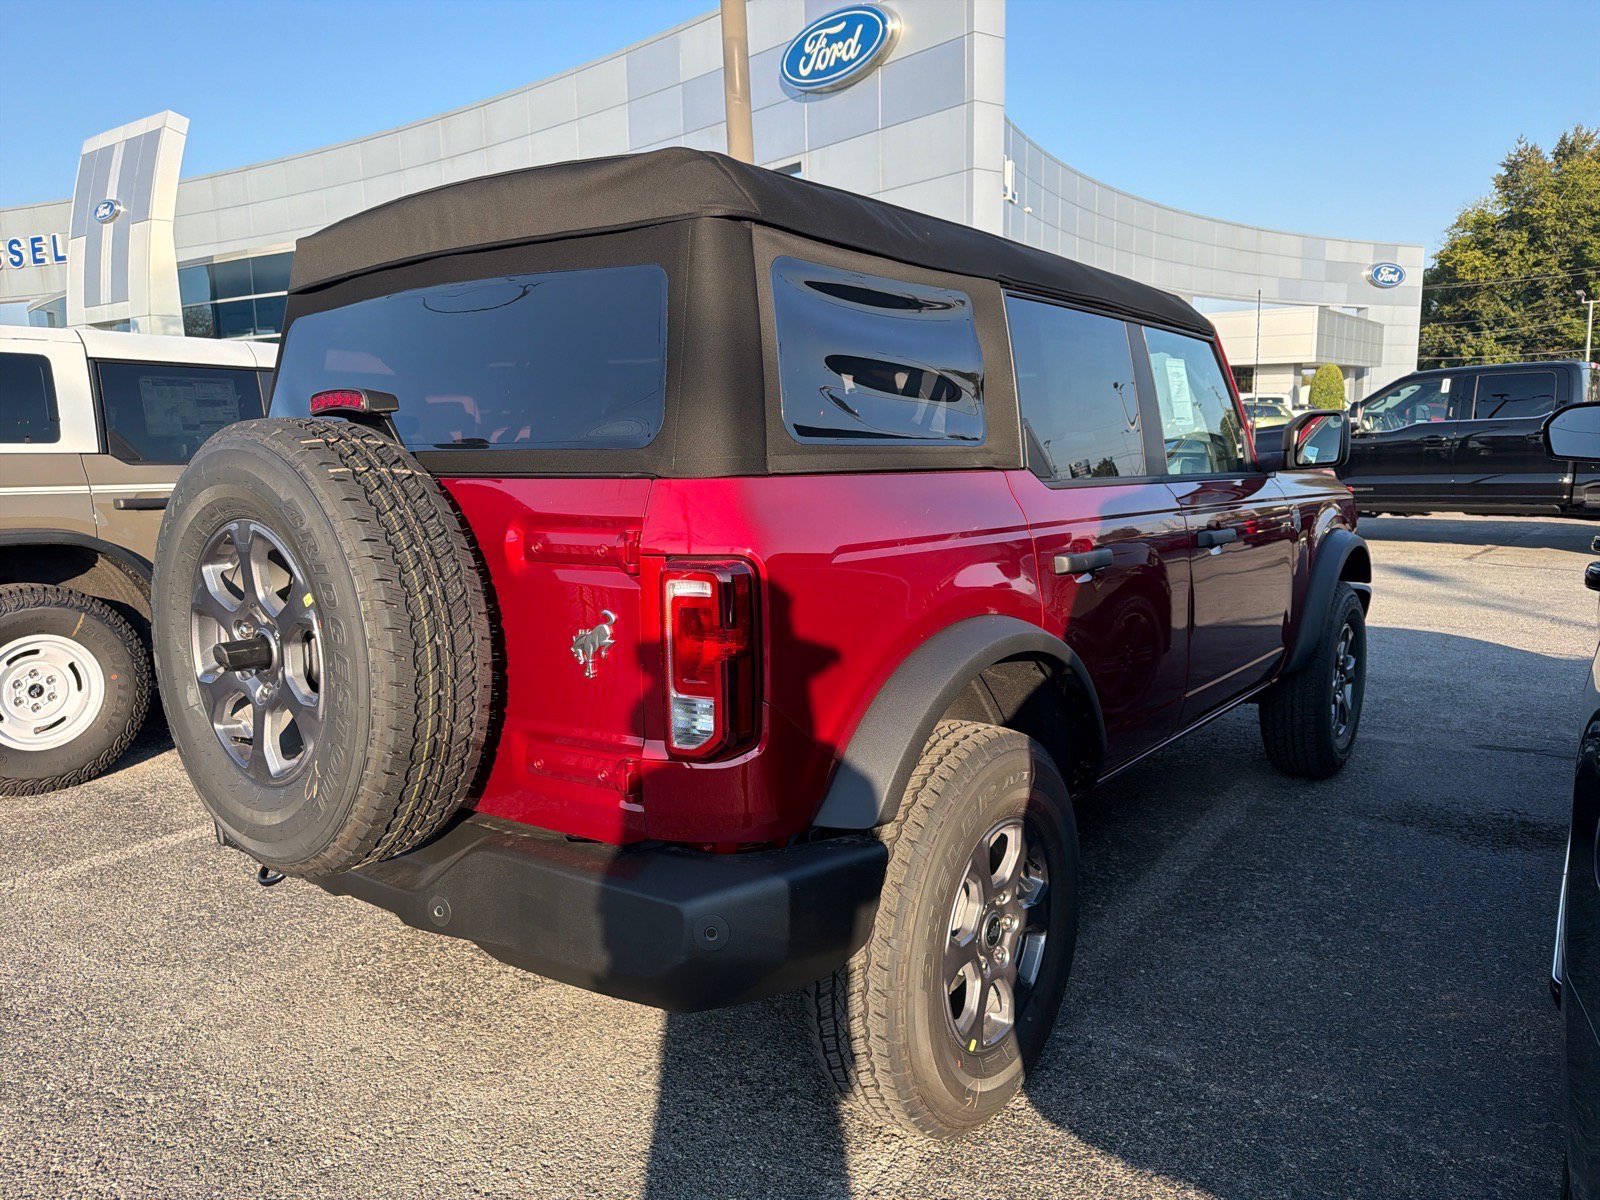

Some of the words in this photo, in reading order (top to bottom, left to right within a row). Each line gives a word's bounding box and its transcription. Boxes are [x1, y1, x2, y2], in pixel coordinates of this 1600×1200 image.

[798, 21, 863, 77] Ford
[0, 233, 68, 269] SEL
[1377, 266, 1400, 282] Ford
